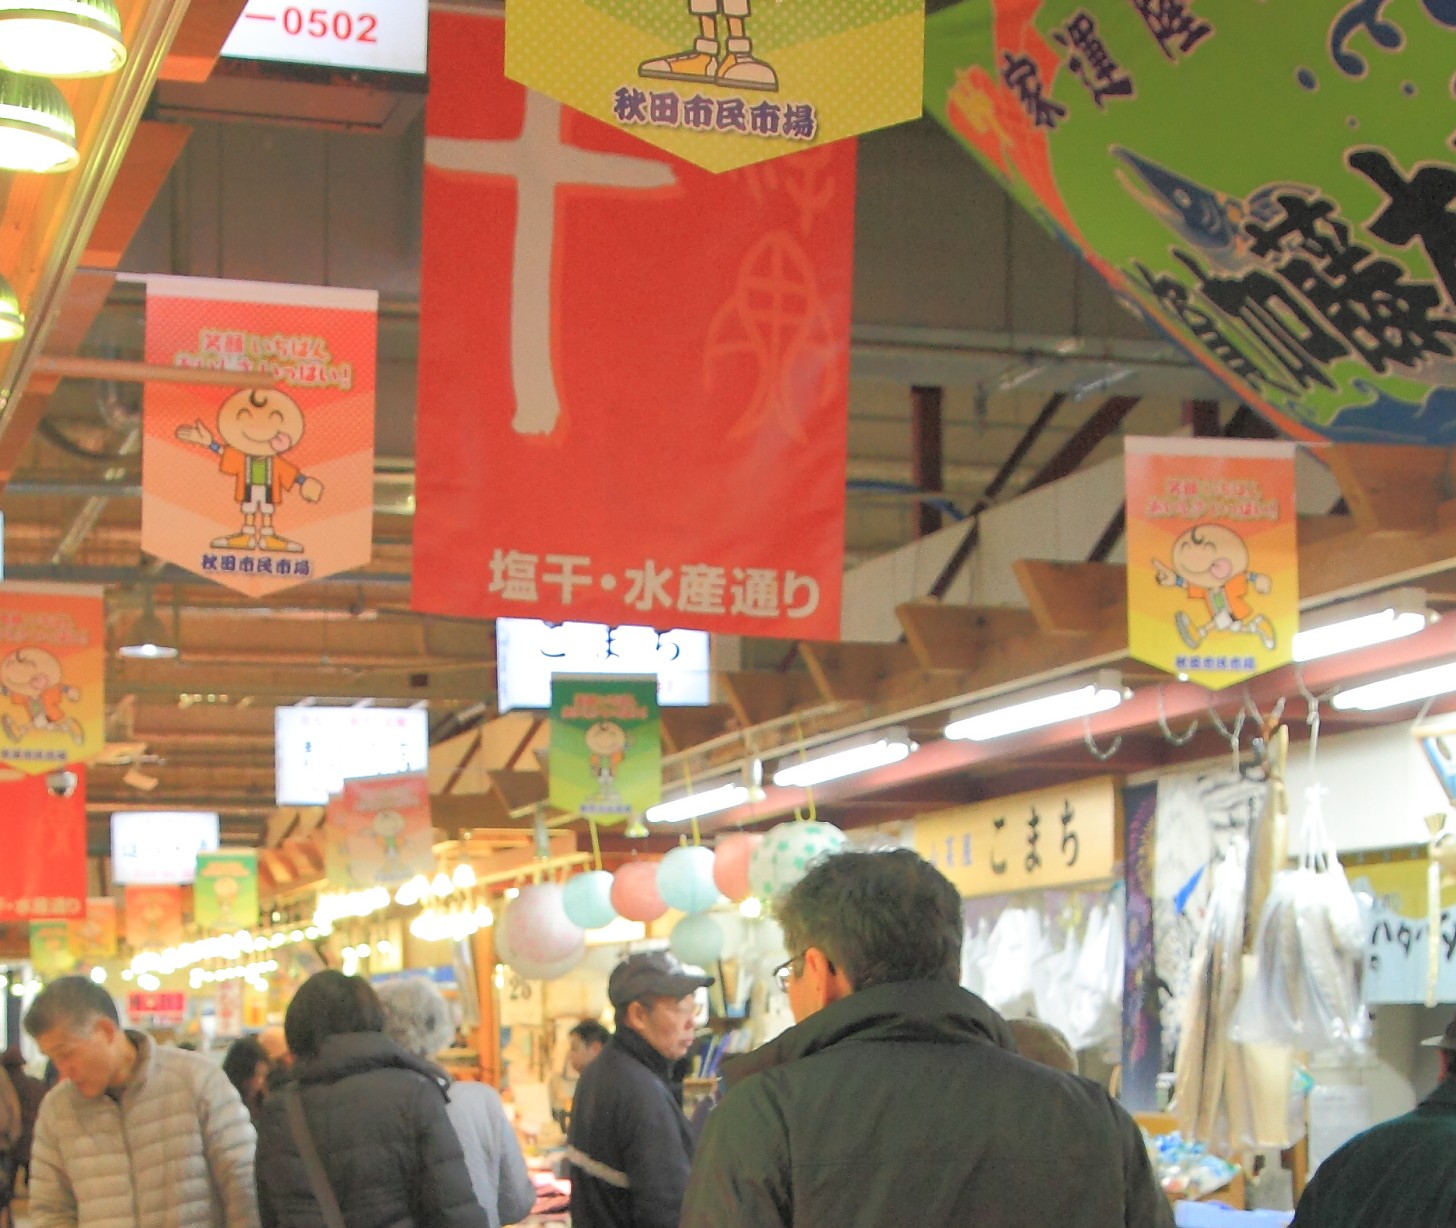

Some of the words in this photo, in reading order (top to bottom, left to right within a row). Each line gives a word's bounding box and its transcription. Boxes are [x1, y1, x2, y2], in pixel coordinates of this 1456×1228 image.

[612, 86, 817, 139] 秋田市民市場
[199, 328, 247, 356] 笑顔
[201, 554, 313, 578] 秋田市民市場
[488, 548, 821, 621] 塩干・水産通り
[990, 797, 1080, 876] こまち
